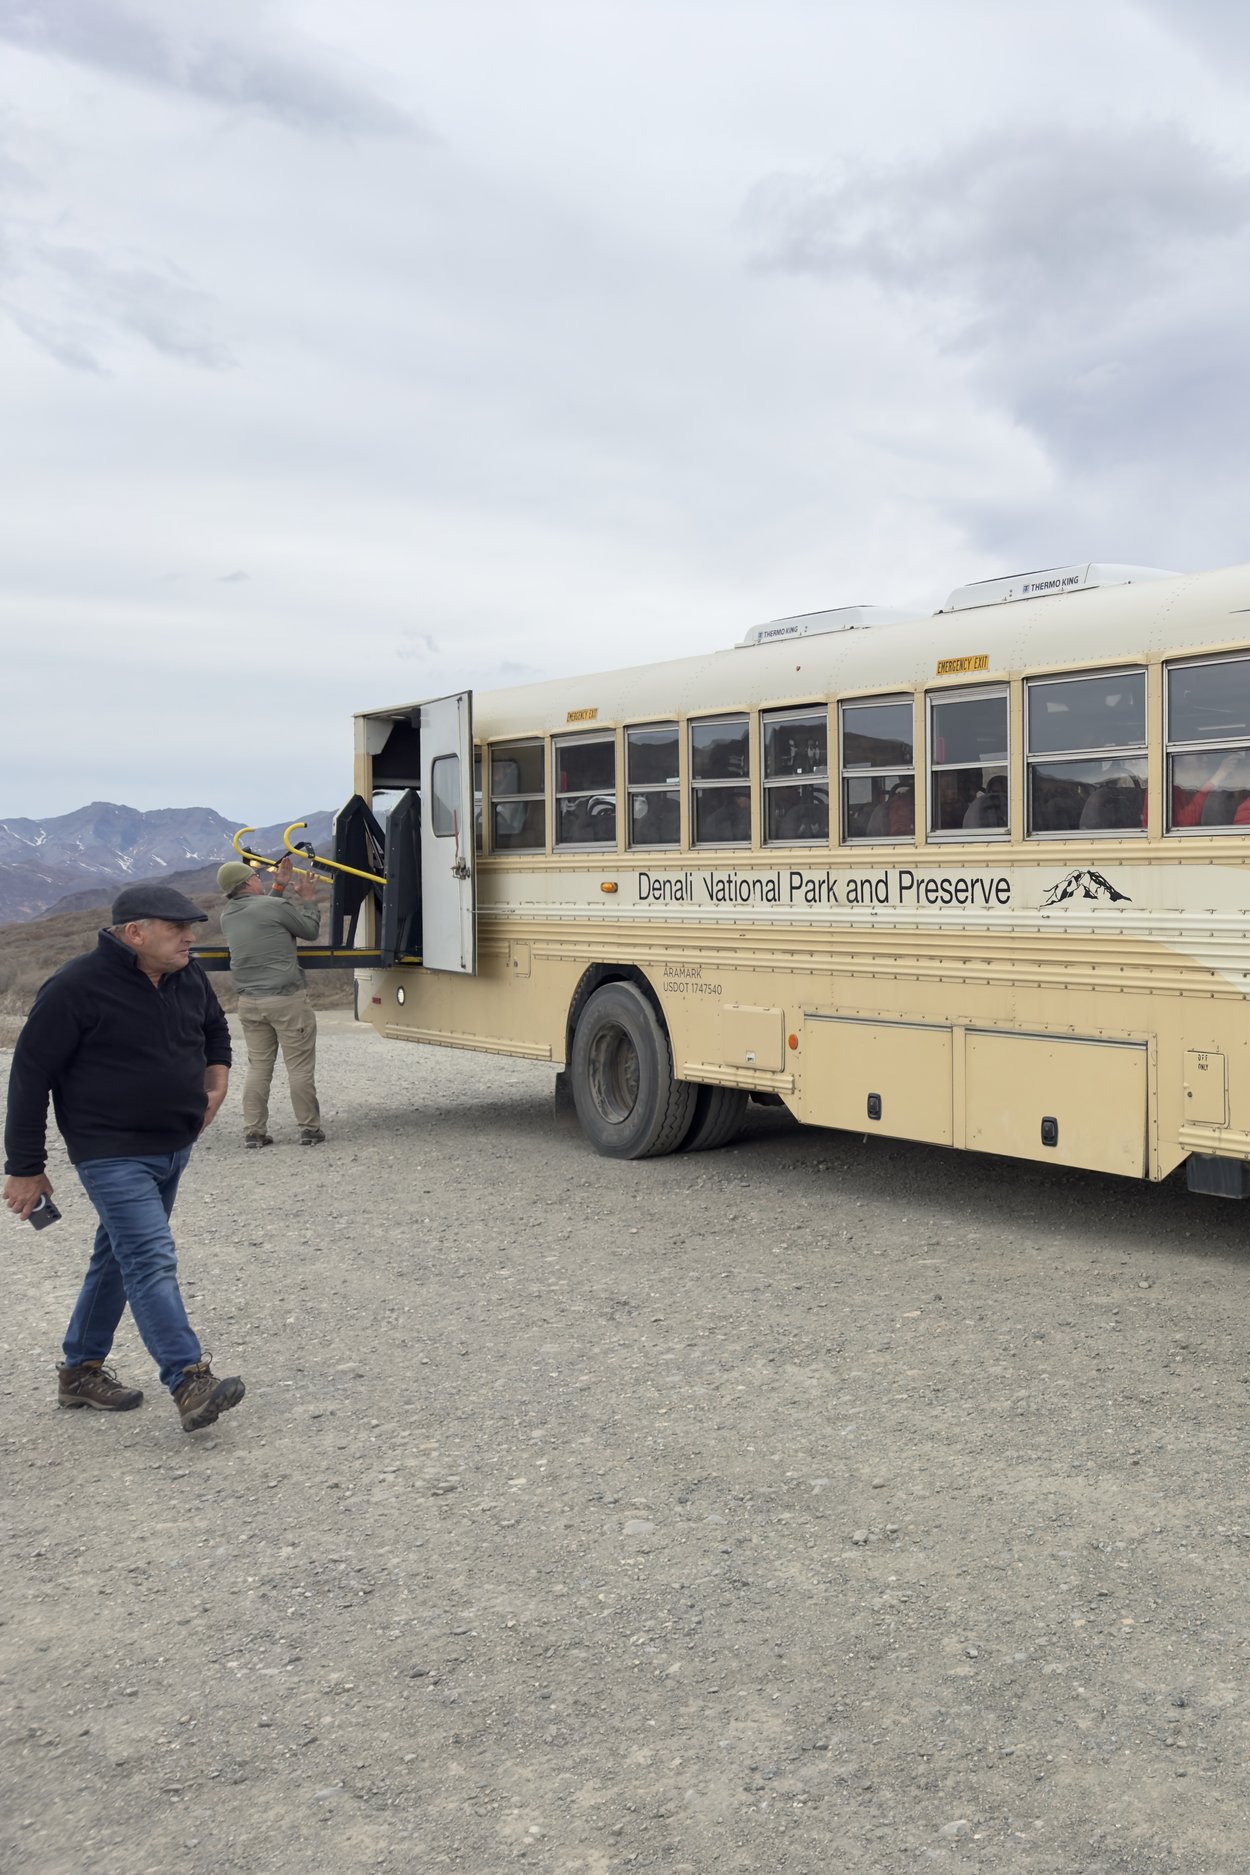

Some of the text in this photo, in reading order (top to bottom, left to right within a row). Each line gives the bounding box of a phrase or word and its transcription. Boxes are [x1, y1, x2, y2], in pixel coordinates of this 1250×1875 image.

[1031, 576, 1079, 592] THERMO KING
[764, 625, 799, 638] THERMO KING
[937, 655, 988, 674] EMERGENCY EXIT
[638, 870, 1011, 905] Denali National Park and Preserve
[663, 967, 702, 979] ARAMARK
[663, 981, 722, 995] USDOT 1747540
